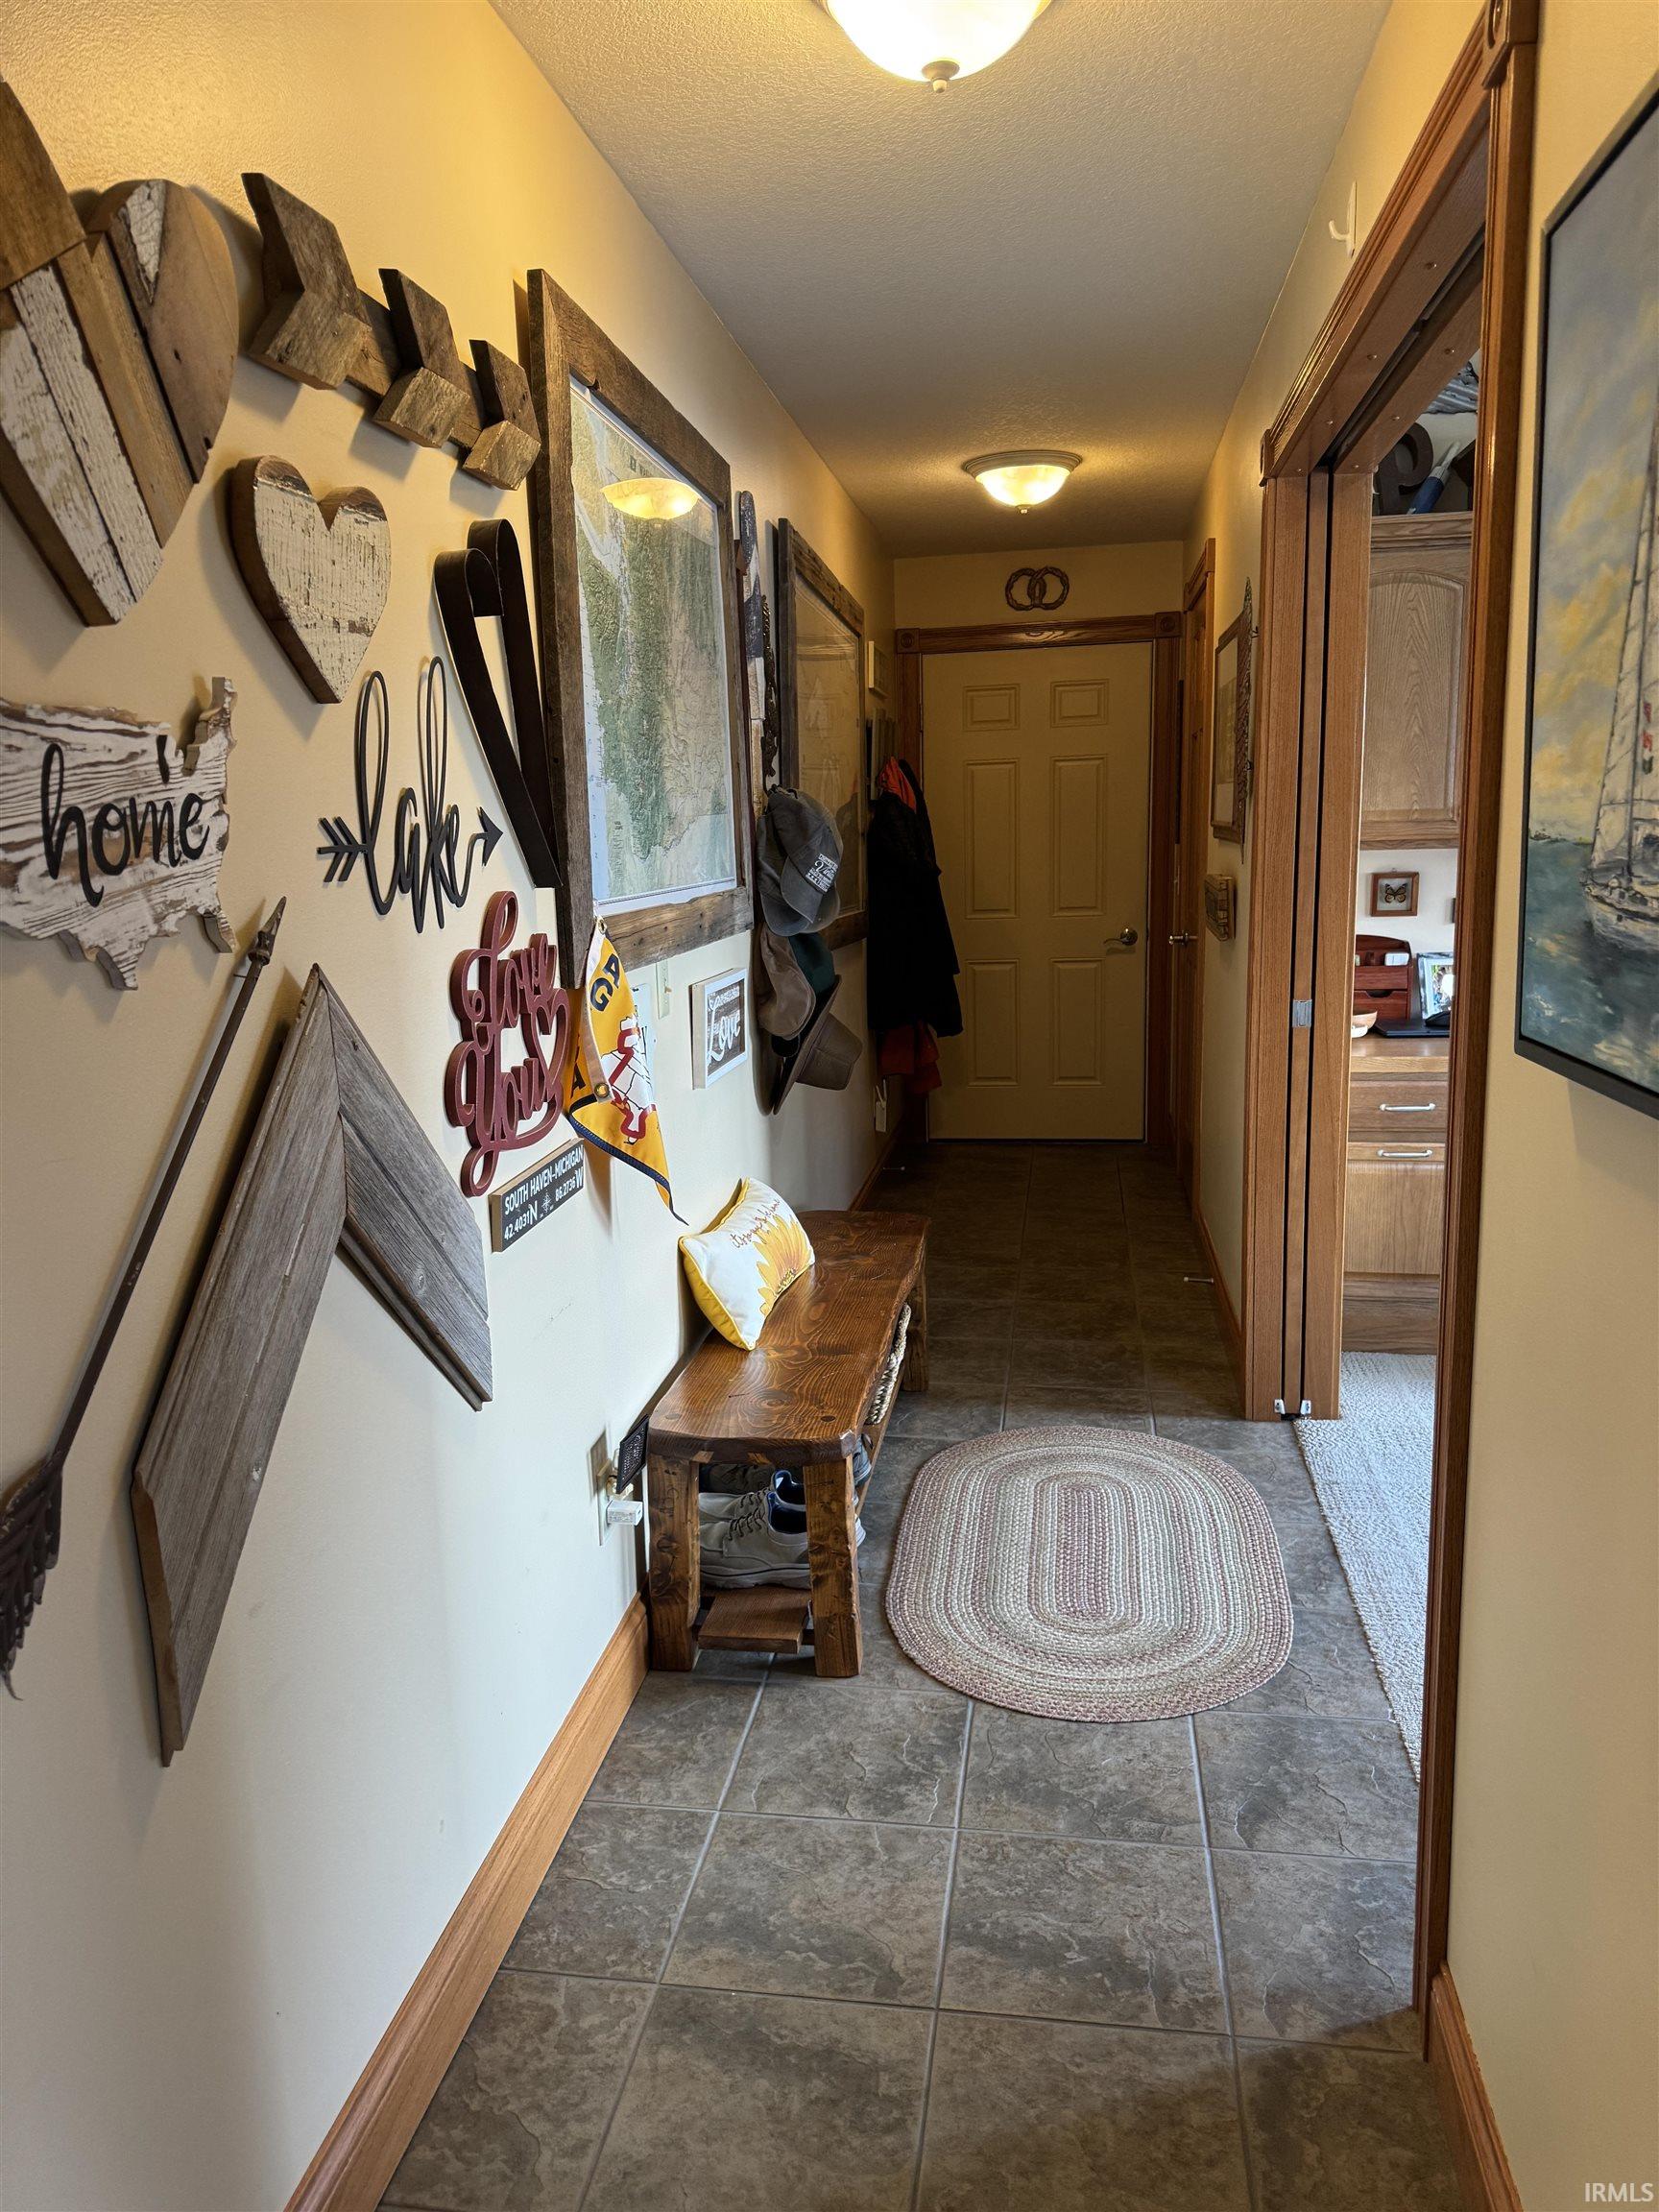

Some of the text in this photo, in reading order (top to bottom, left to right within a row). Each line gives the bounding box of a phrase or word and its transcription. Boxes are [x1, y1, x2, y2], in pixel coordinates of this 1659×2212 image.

[41, 743, 209, 907] home
[355, 656, 482, 934] lake
[504, 1183, 529, 1215] SOUTH
